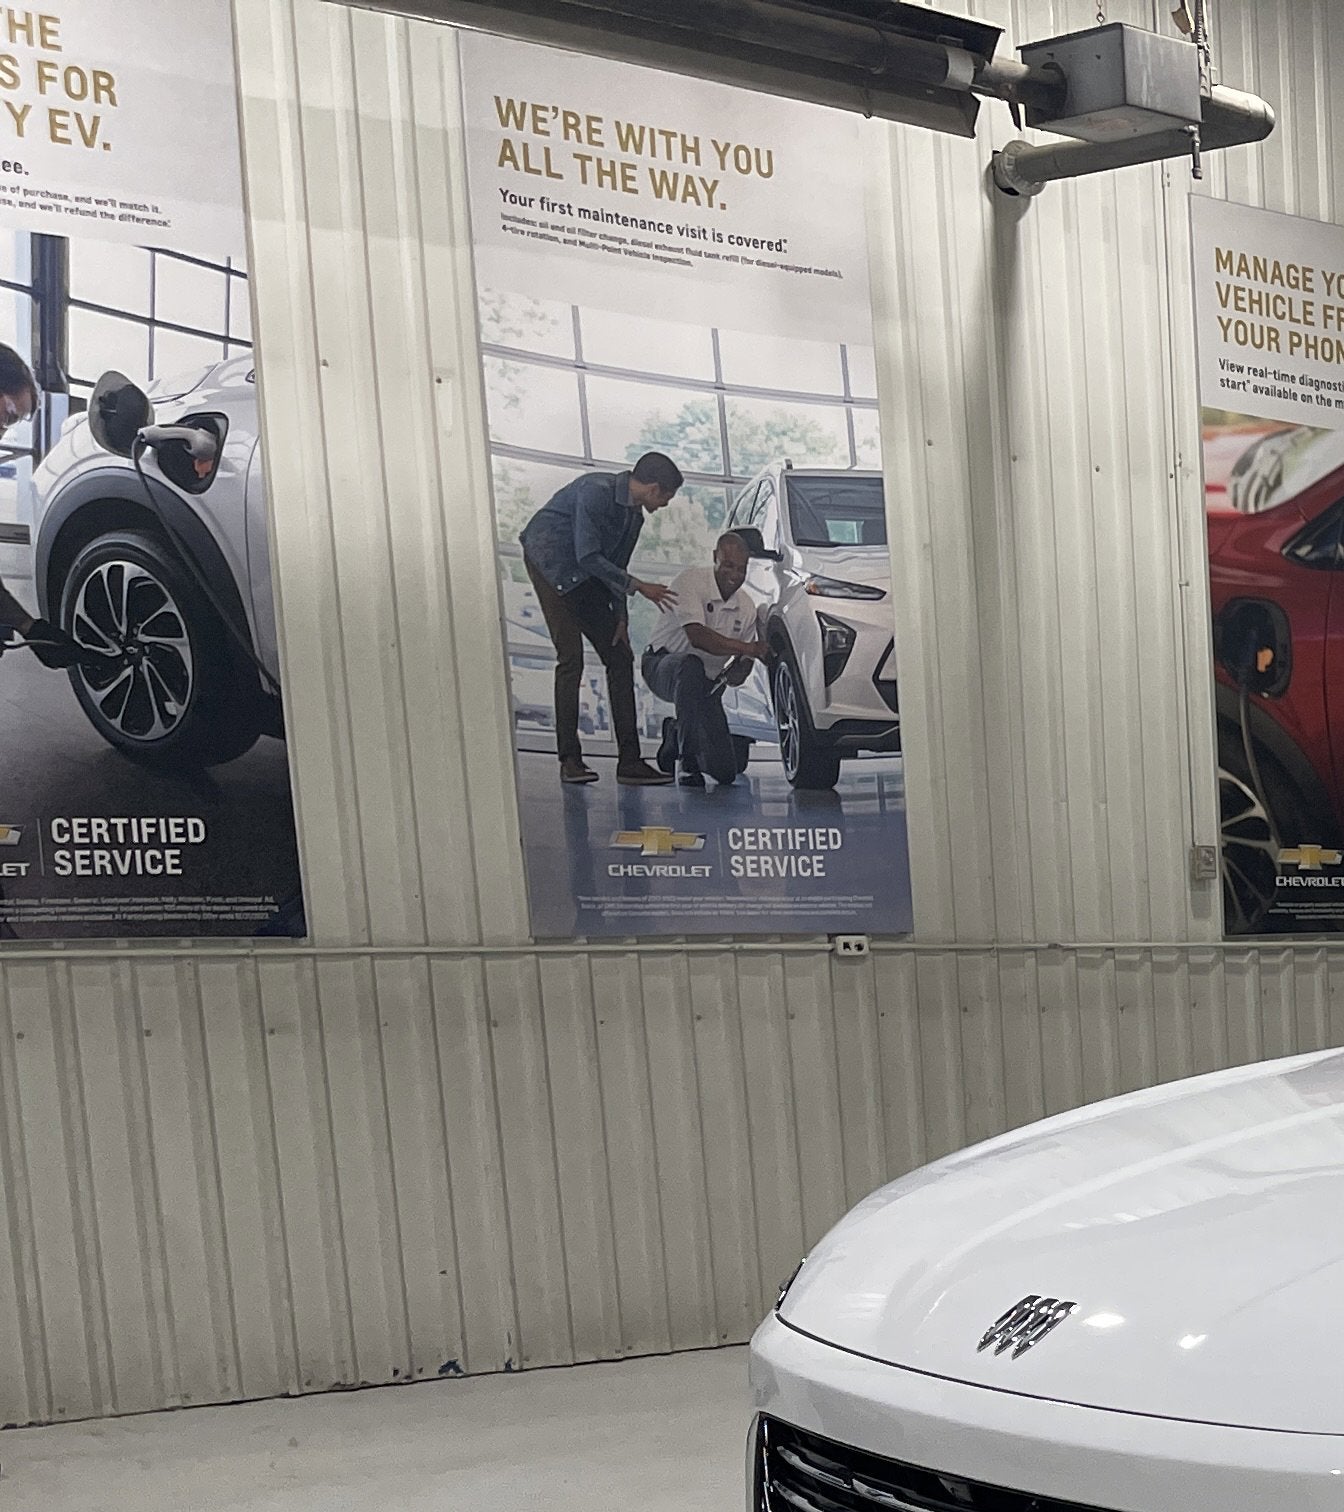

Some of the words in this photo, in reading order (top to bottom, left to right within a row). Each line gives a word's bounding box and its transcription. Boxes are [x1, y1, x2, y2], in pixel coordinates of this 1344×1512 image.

[0, 7, 63, 52] HE
[37, 60, 118, 107] FOR
[48, 108, 112, 151] EV.
[494, 95, 604, 148] WE'RE
[615, 120, 701, 167] WITH
[711, 139, 774, 179] YOU
[498, 138, 563, 181] ALL
[573, 152, 638, 195] THE
[648, 167, 727, 211] WAY.
[499, 187, 535, 208] Your
[540, 197, 573, 216] first
[578, 207, 673, 235] maintenance
[677, 223, 708, 241] visit
[712, 228, 724, 244] is
[1215, 246, 1315, 294] MANAGE
[1215, 281, 1315, 327] VEHICLE
[1217, 315, 1281, 354] YOUR
[1218, 357, 1244, 375] View
[1248, 363, 1296, 386] real-time
[1252, 382, 1298, 402] available
[1300, 392, 1313, 404] on
[1315, 393, 1332, 408] the
[51, 817, 206, 844] CERTIFIED
[727, 827, 843, 851] CERTIFIED
[0, 862, 31, 877] ET
[53, 849, 183, 876] SERVICE
[607, 864, 713, 878] CHEVROLET
[730, 854, 826, 878] SERVICE
